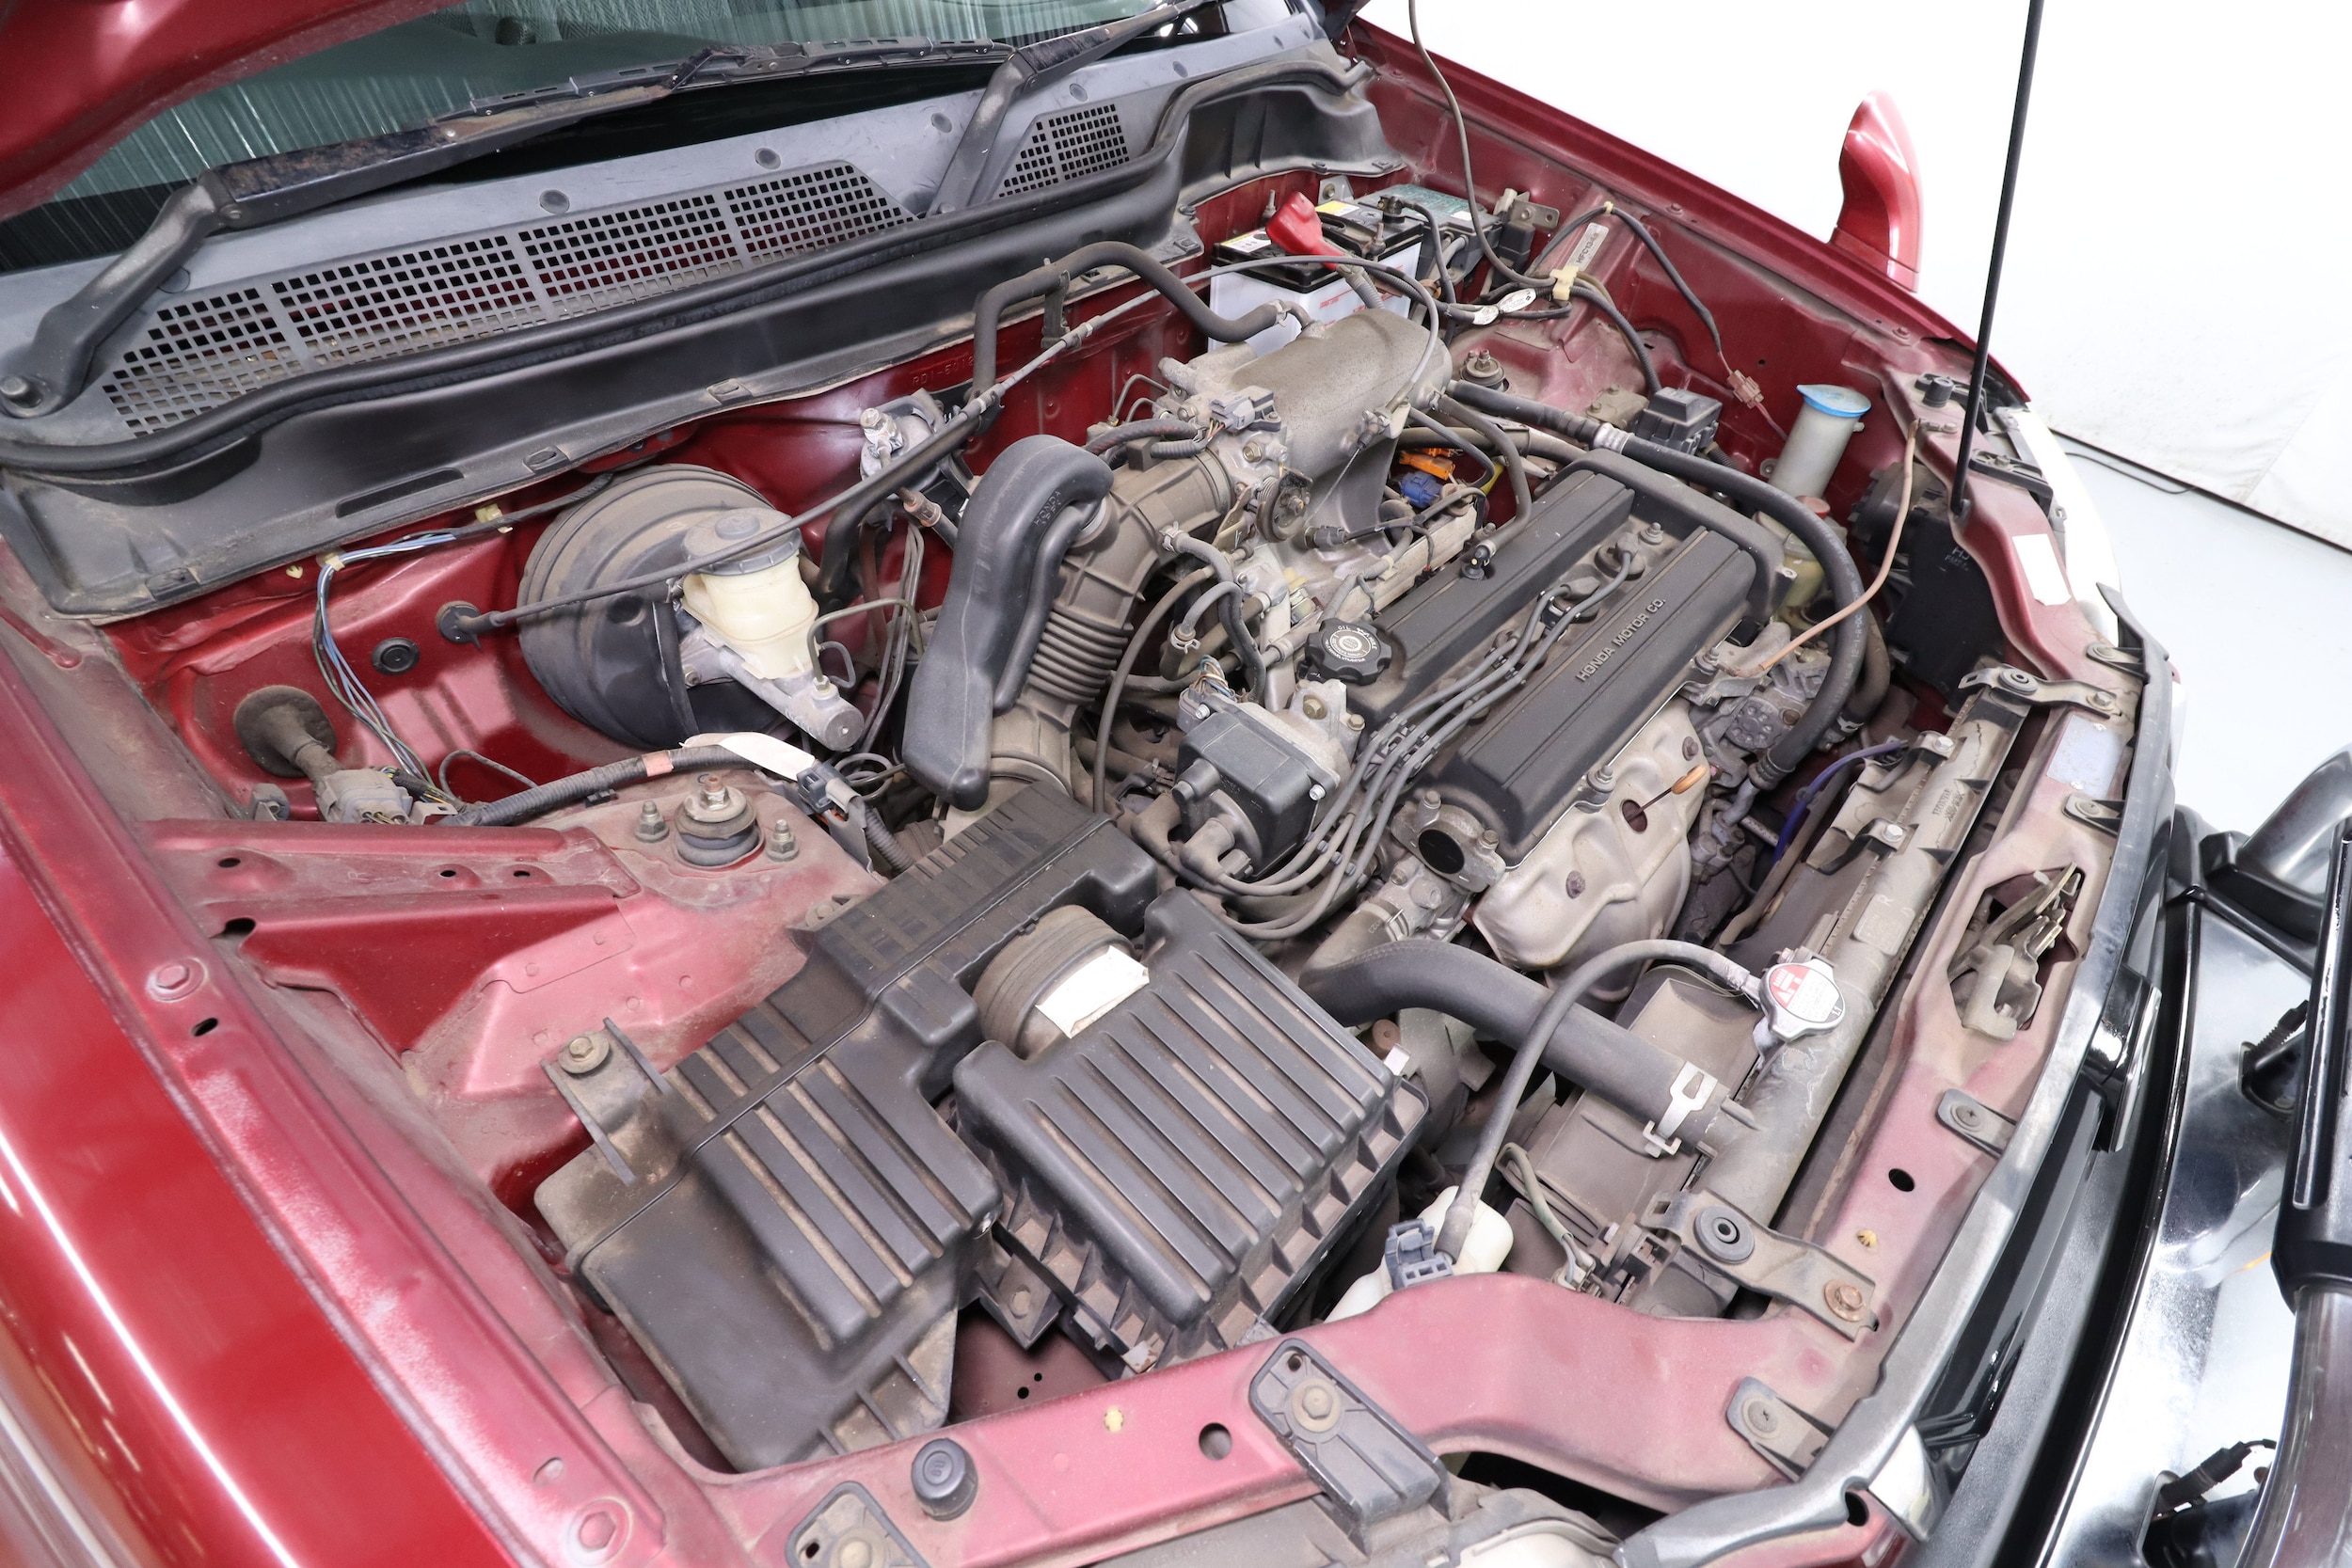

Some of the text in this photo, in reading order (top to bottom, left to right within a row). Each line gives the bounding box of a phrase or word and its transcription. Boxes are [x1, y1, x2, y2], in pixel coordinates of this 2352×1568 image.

[1575, 598, 1666, 682] HONDA MOTOR CO.
